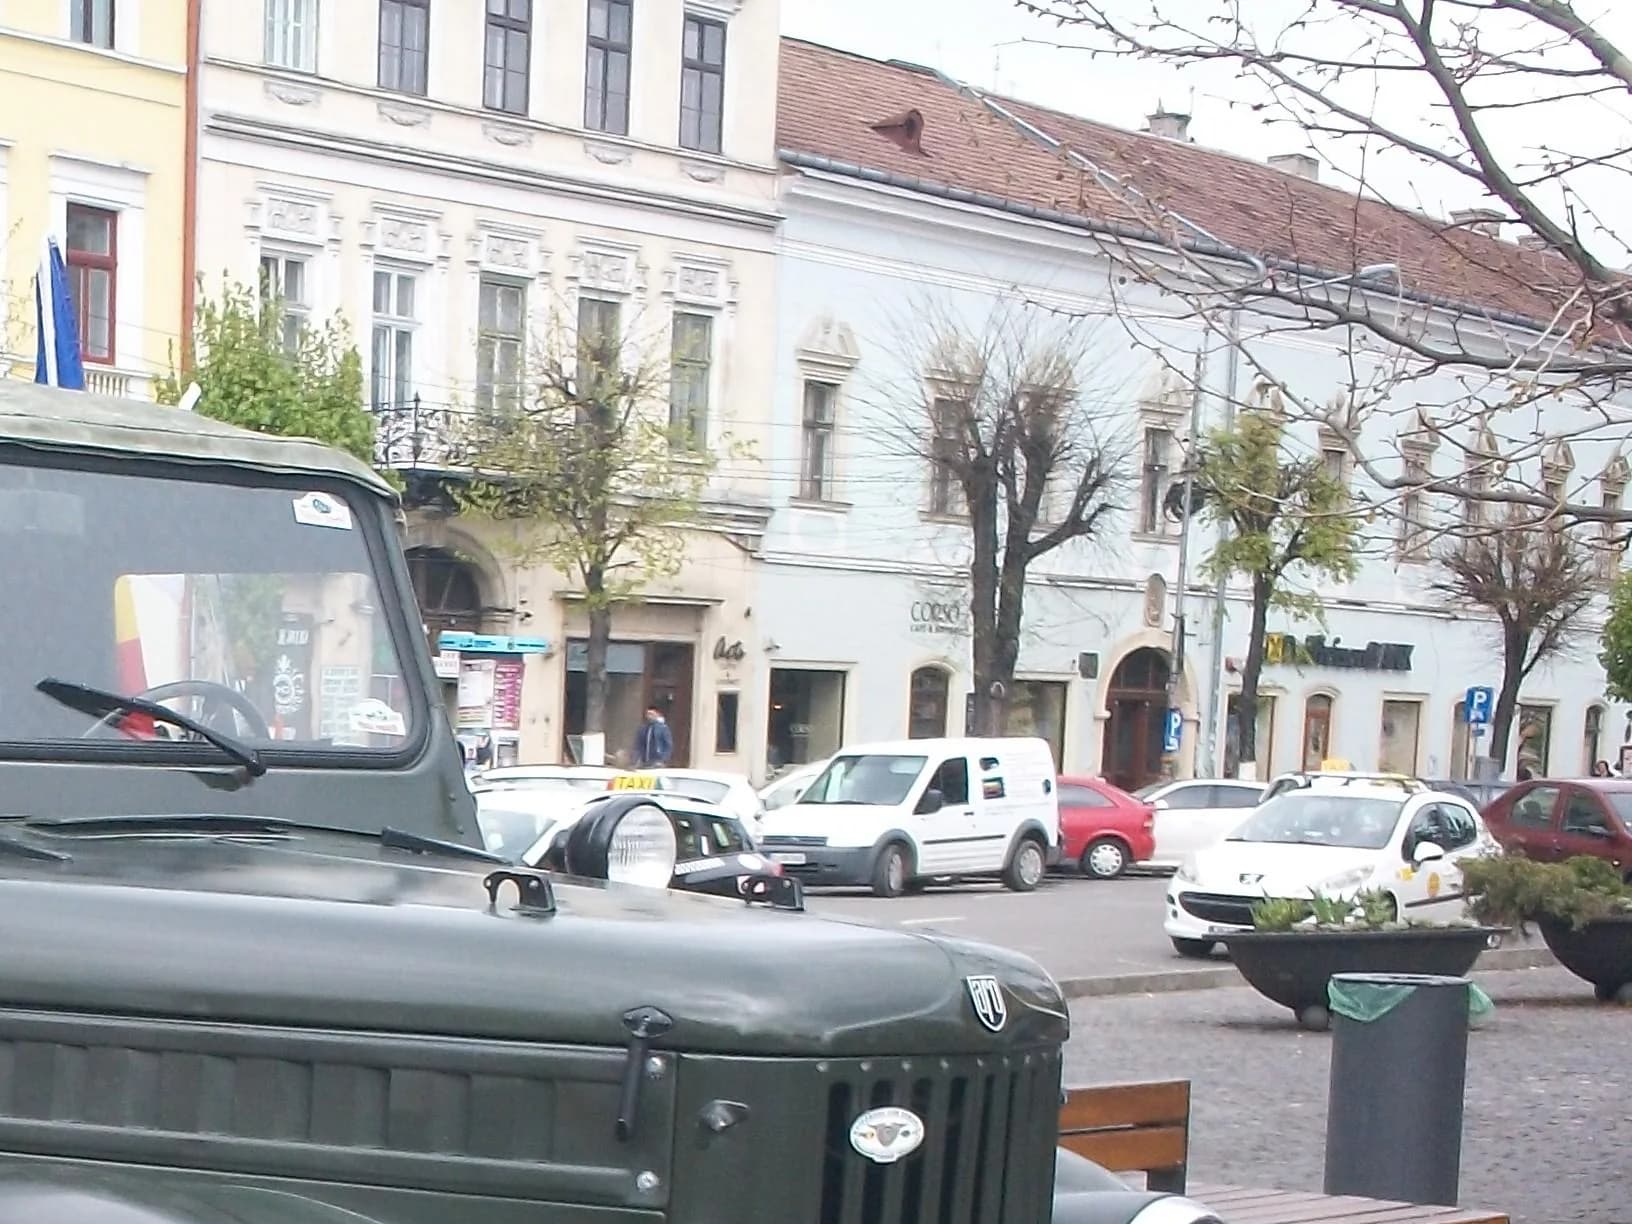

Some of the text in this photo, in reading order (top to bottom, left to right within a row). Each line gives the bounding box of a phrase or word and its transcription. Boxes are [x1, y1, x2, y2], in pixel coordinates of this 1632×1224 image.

[1473, 691, 1487, 709] P
[1170, 712, 1182, 737] P
[617, 776, 653, 790] TAXI
